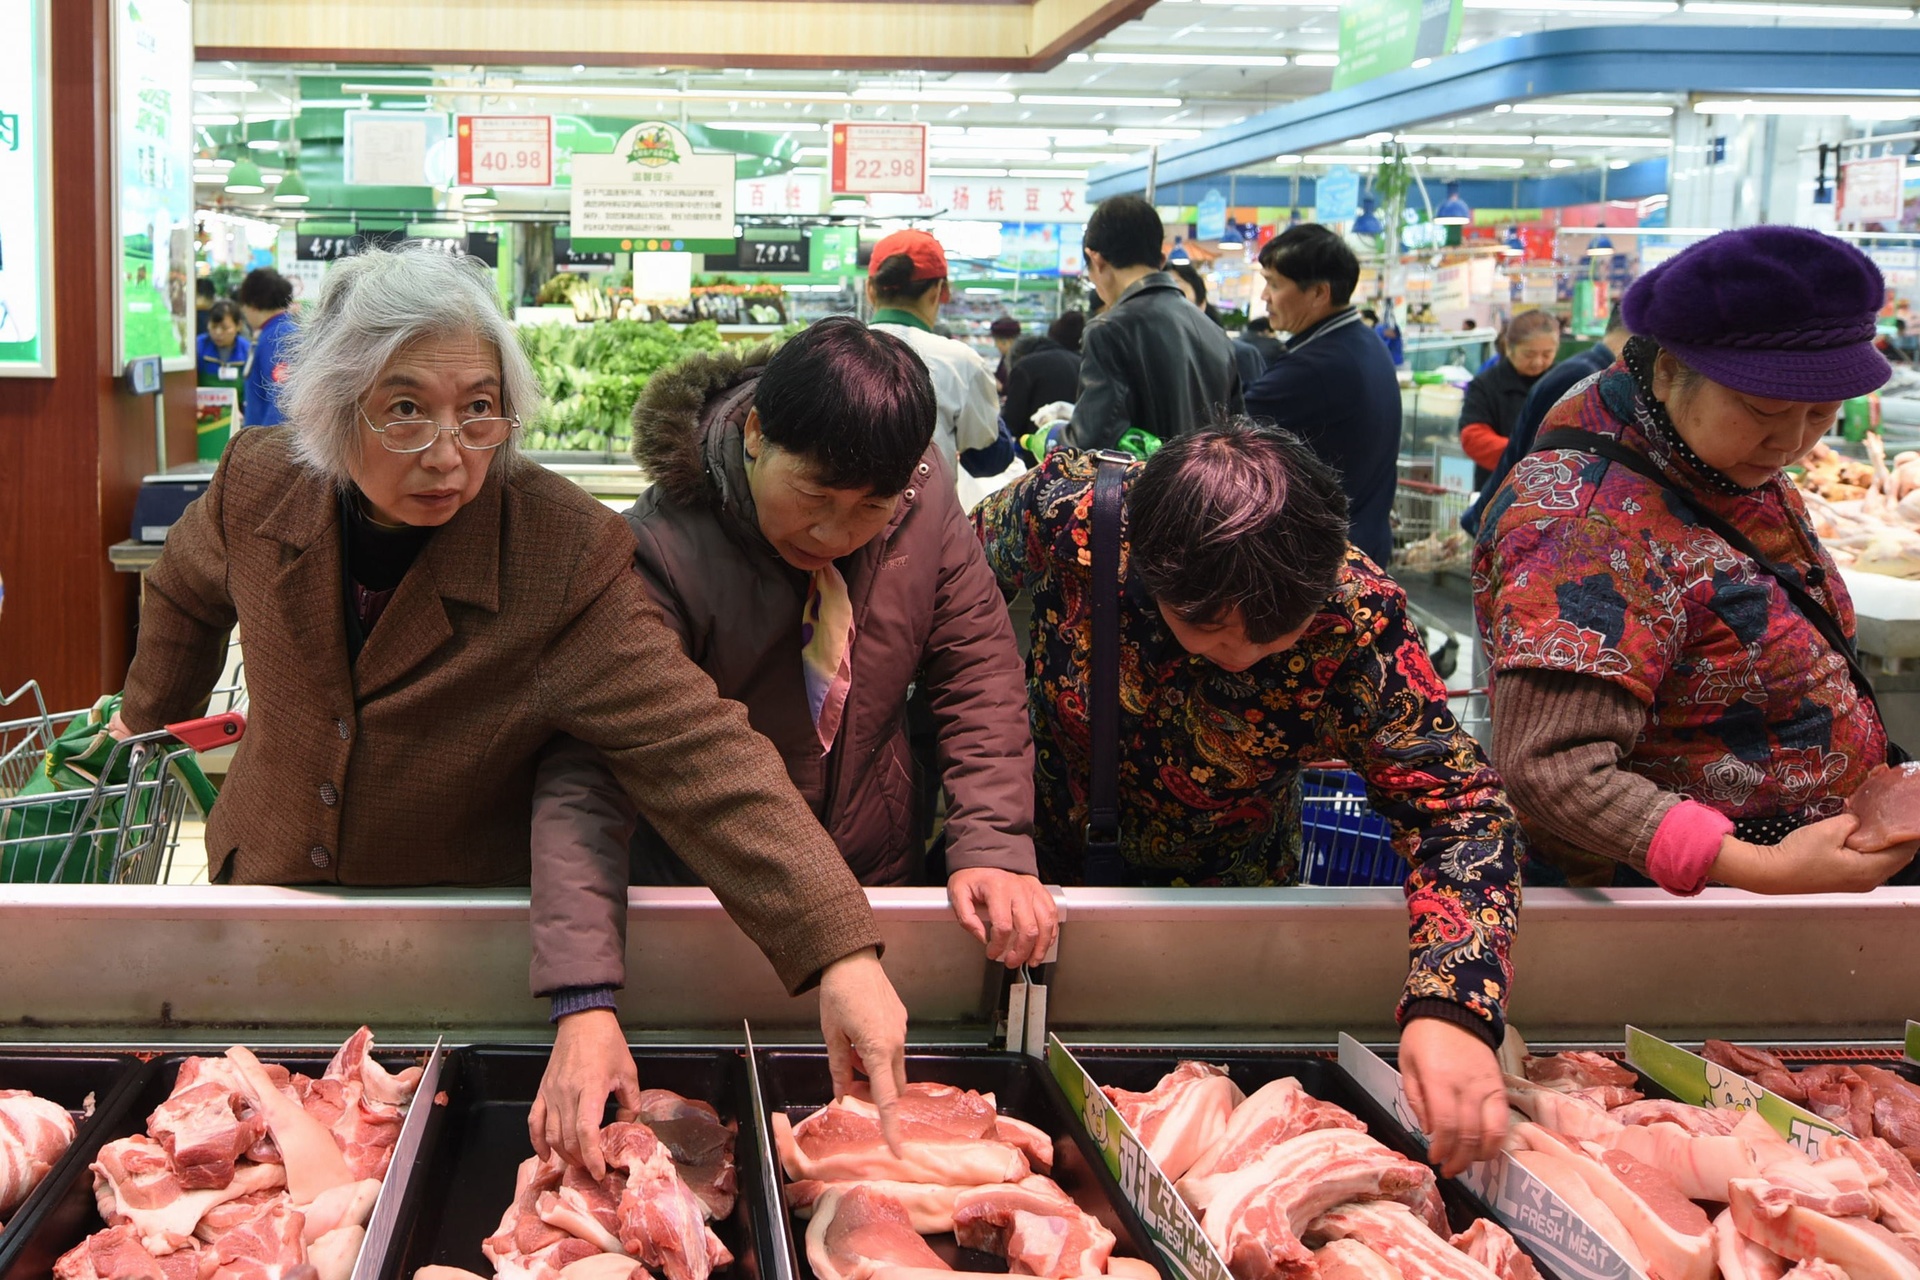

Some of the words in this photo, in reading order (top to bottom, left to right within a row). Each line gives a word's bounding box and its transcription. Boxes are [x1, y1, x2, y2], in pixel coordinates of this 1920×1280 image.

[480, 151, 541, 171] 40.98
[855, 159, 915, 178] 22.98
[1157, 1217, 1185, 1256] FRESH
[1187, 1245, 1212, 1279] MEAT
[1519, 1204, 1564, 1244] FRESH
[1568, 1234, 1610, 1269] MEAT
